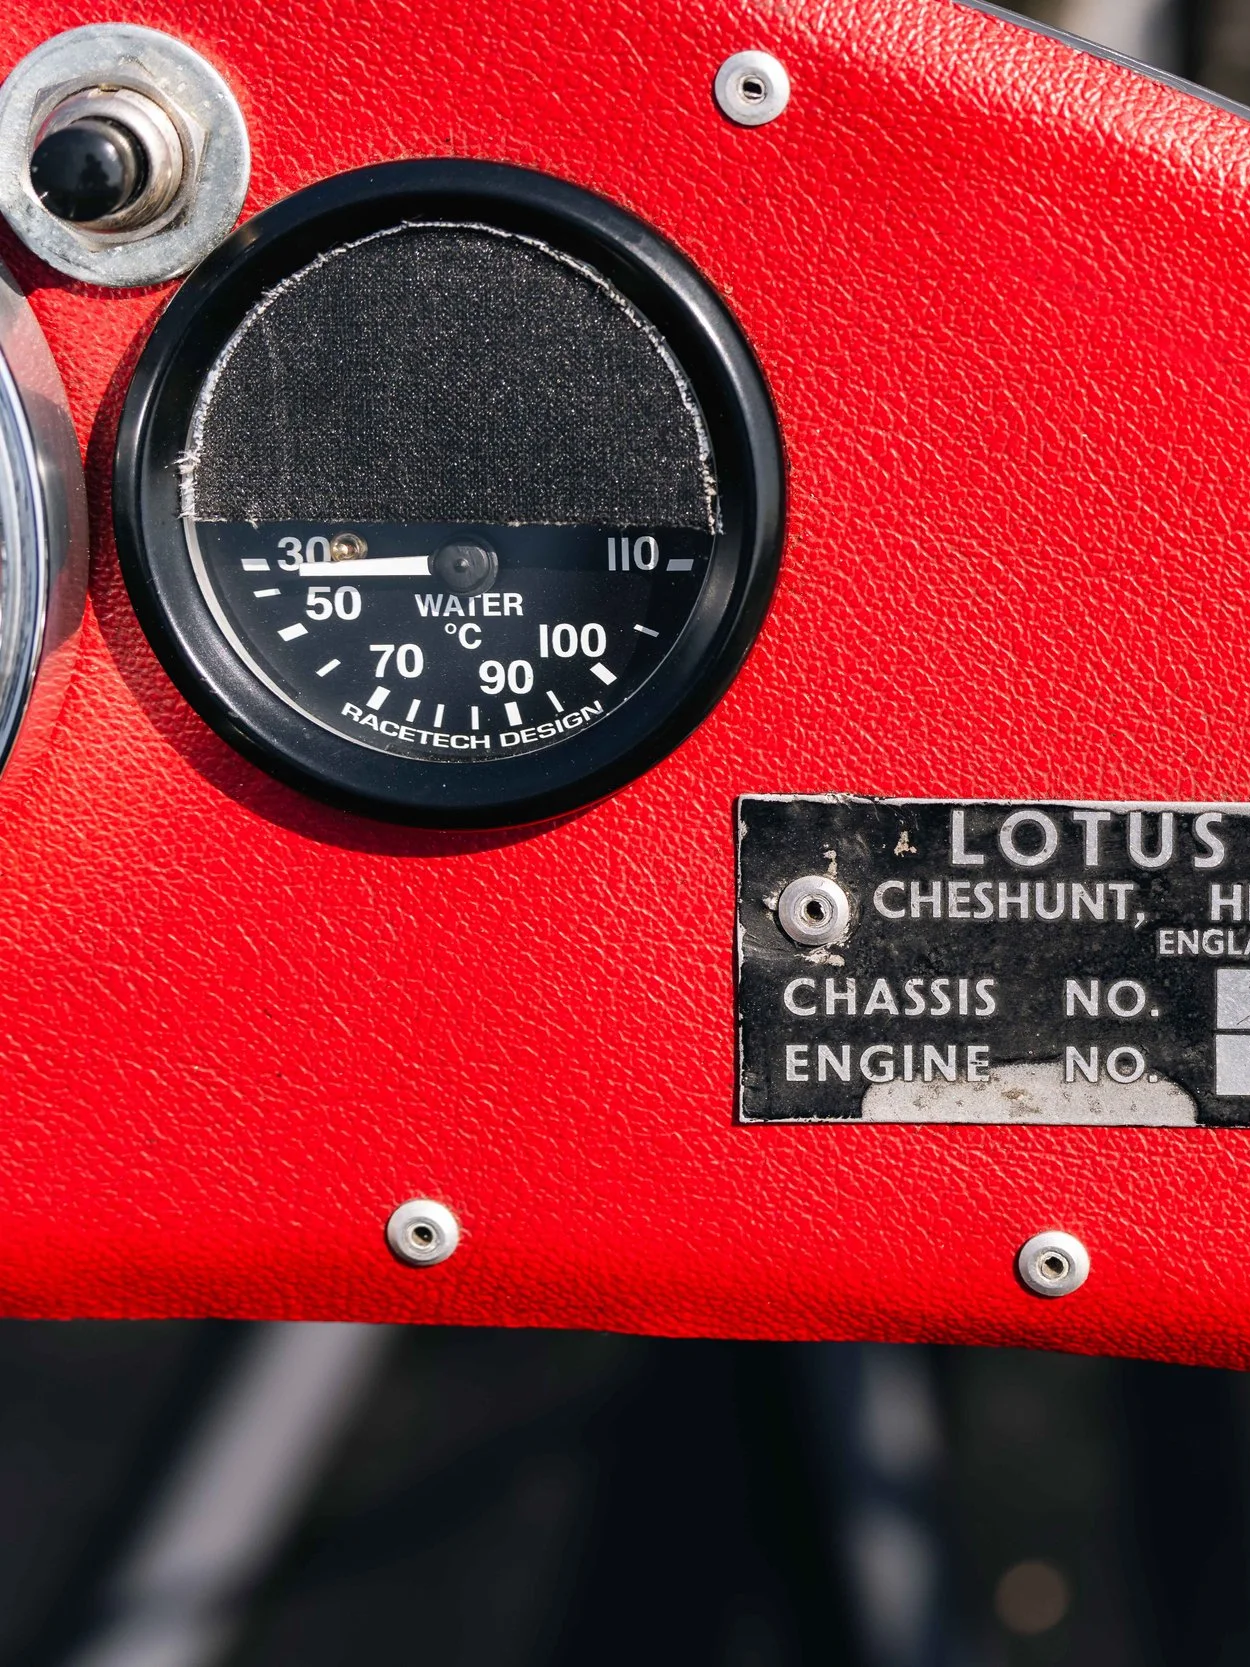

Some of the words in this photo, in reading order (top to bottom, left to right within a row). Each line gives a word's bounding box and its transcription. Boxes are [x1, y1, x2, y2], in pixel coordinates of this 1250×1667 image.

[277, 536, 332, 572] 30
[607, 536, 660, 571] 110
[305, 585, 362, 621] 50
[414, 592, 525, 617] WATER
[538, 622, 607, 658] 100
[369, 643, 424, 678] 70
[478, 659, 534, 695] 90
[341, 702, 491, 749] RACETECH
[499, 700, 604, 748] DESIGN
[950, 809, 1227, 869] LOTUS
[872, 880, 1147, 929] CHESHUNT,
[783, 977, 997, 1017] CHASSIS
[1065, 979, 1160, 1017] NO.
[785, 1044, 991, 1083] ENGINE
[1065, 1046, 1159, 1084] NO.
